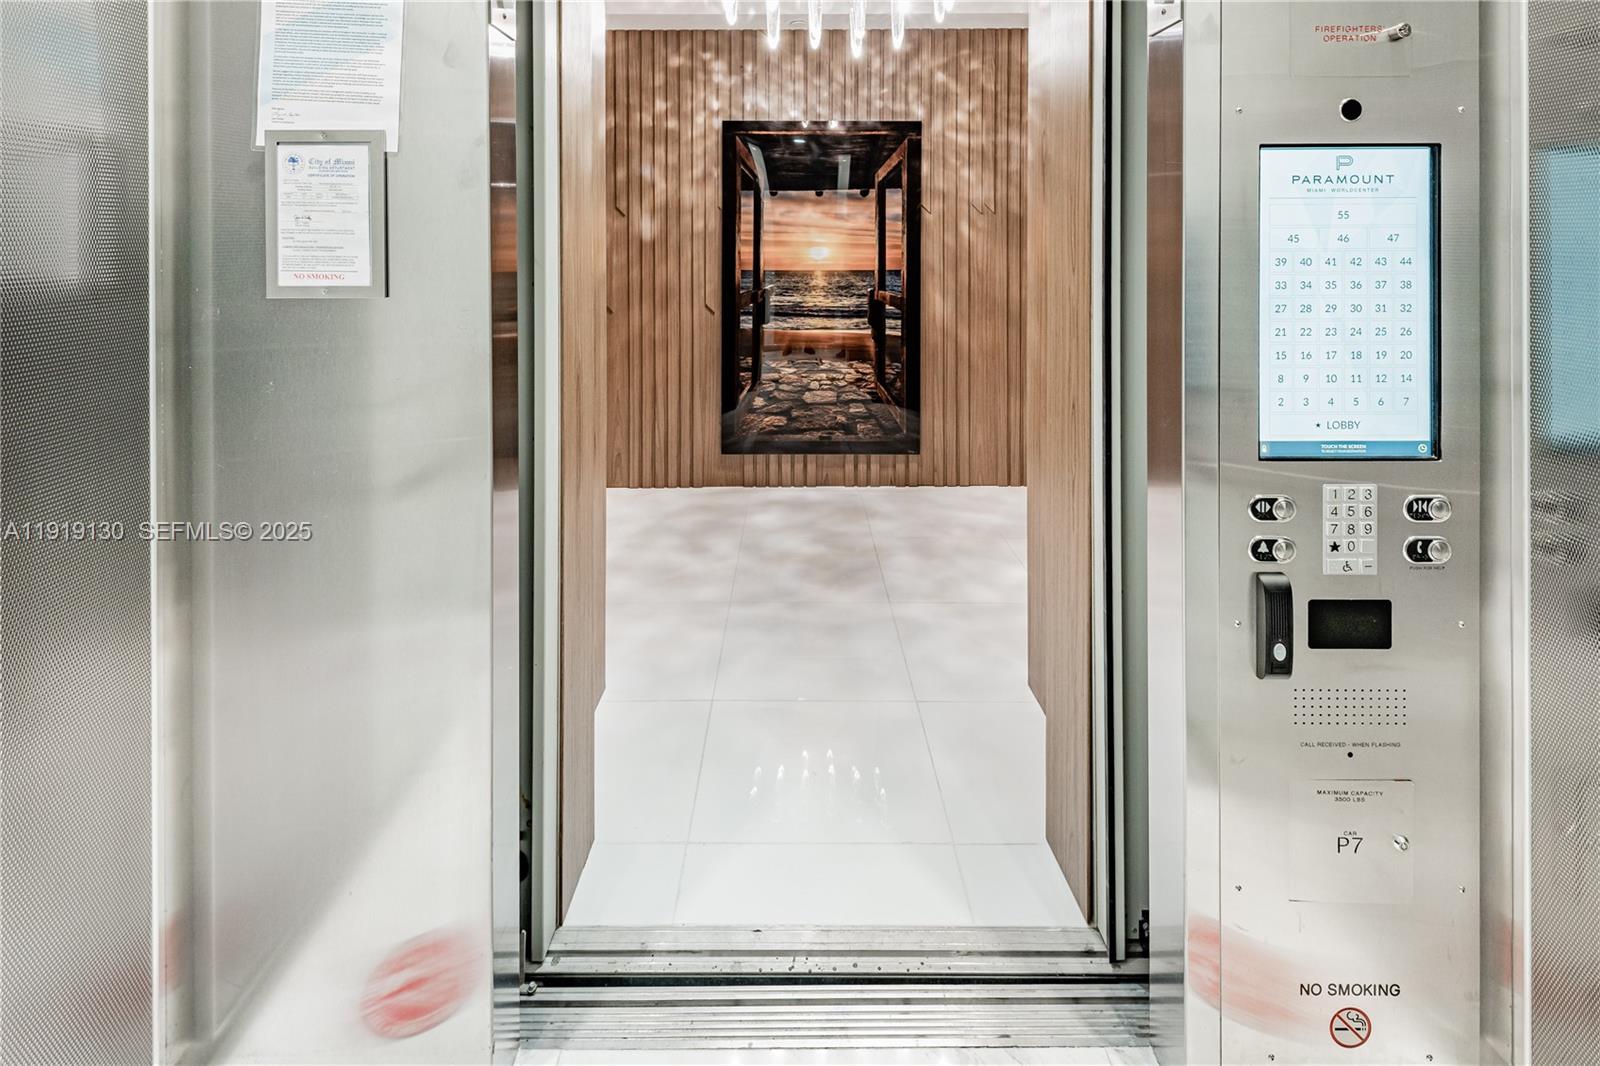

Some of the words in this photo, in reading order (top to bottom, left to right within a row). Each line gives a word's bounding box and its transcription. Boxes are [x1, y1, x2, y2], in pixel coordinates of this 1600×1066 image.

[308, 157, 323, 166] City
[1292, 175, 1394, 184] PARAMOUNT
[1338, 211, 1349, 219] 55
[1288, 234, 1299, 243] 45
[1337, 234, 1349, 242] 46
[1387, 234, 1399, 243] 47
[1275, 258, 1287, 266] 39
[1300, 258, 1312, 266] 40
[1325, 258, 1336, 266] 41
[1350, 257, 1361, 266] 42
[1375, 257, 1387, 266] 43
[1400, 257, 1412, 265] 44
[1275, 281, 1287, 289] 33
[1300, 281, 1311, 289] 34
[1325, 281, 1336, 289] 35
[1350, 281, 1362, 289] 36
[1375, 281, 1387, 289] 37
[1400, 280, 1412, 289] 38
[1275, 304, 1286, 313] 27
[1300, 304, 1312, 312] 28
[1325, 304, 1337, 312] 29
[1350, 304, 1362, 312] 30
[1376, 304, 1386, 312] 31
[1400, 304, 1412, 312] 32
[1275, 328, 1286, 336] 21
[1300, 328, 1312, 336] 22
[1325, 328, 1337, 336] 23
[1350, 328, 1361, 336] 24
[1375, 327, 1386, 336] 25
[1400, 328, 1412, 336] 26
[1276, 351, 1286, 360] 15
[1327, 351, 1337, 359] 17
[1352, 351, 1362, 359] 18
[1376, 351, 1387, 359] 19
[1400, 351, 1412, 359] 20
[1278, 375, 1283, 383] 8
[1303, 374, 1310, 383] 9
[1326, 374, 1337, 383] 10
[1352, 375, 1361, 383] 11
[1377, 374, 1387, 382] 12
[1402, 374, 1412, 382] 14
[1278, 398, 1283, 406] 2
[1304, 398, 1309, 406] 3
[1328, 398, 1334, 406] 4
[1354, 397, 1359, 406] 5
[1378, 398, 1384, 406] 6
[1404, 397, 1409, 405] 7
[1327, 421, 1360, 429] LOBBY
[1332, 489, 1337, 499] 1
[1348, 489, 1355, 500] 2
[1365, 489, 1372, 500] 3
[1331, 507, 1338, 516] 4
[1348, 506, 1355, 517] 5
[1365, 506, 1372, 517] 6
[1331, 524, 1338, 533] 7
[1348, 524, 1355, 535] 8
[1365, 524, 1372, 534] 9
[1348, 541, 1355, 551] 0
[1337, 837, 1363, 853] P7
[1300, 983, 1322, 996] NO
[1328, 983, 1400, 996] SMOKING
